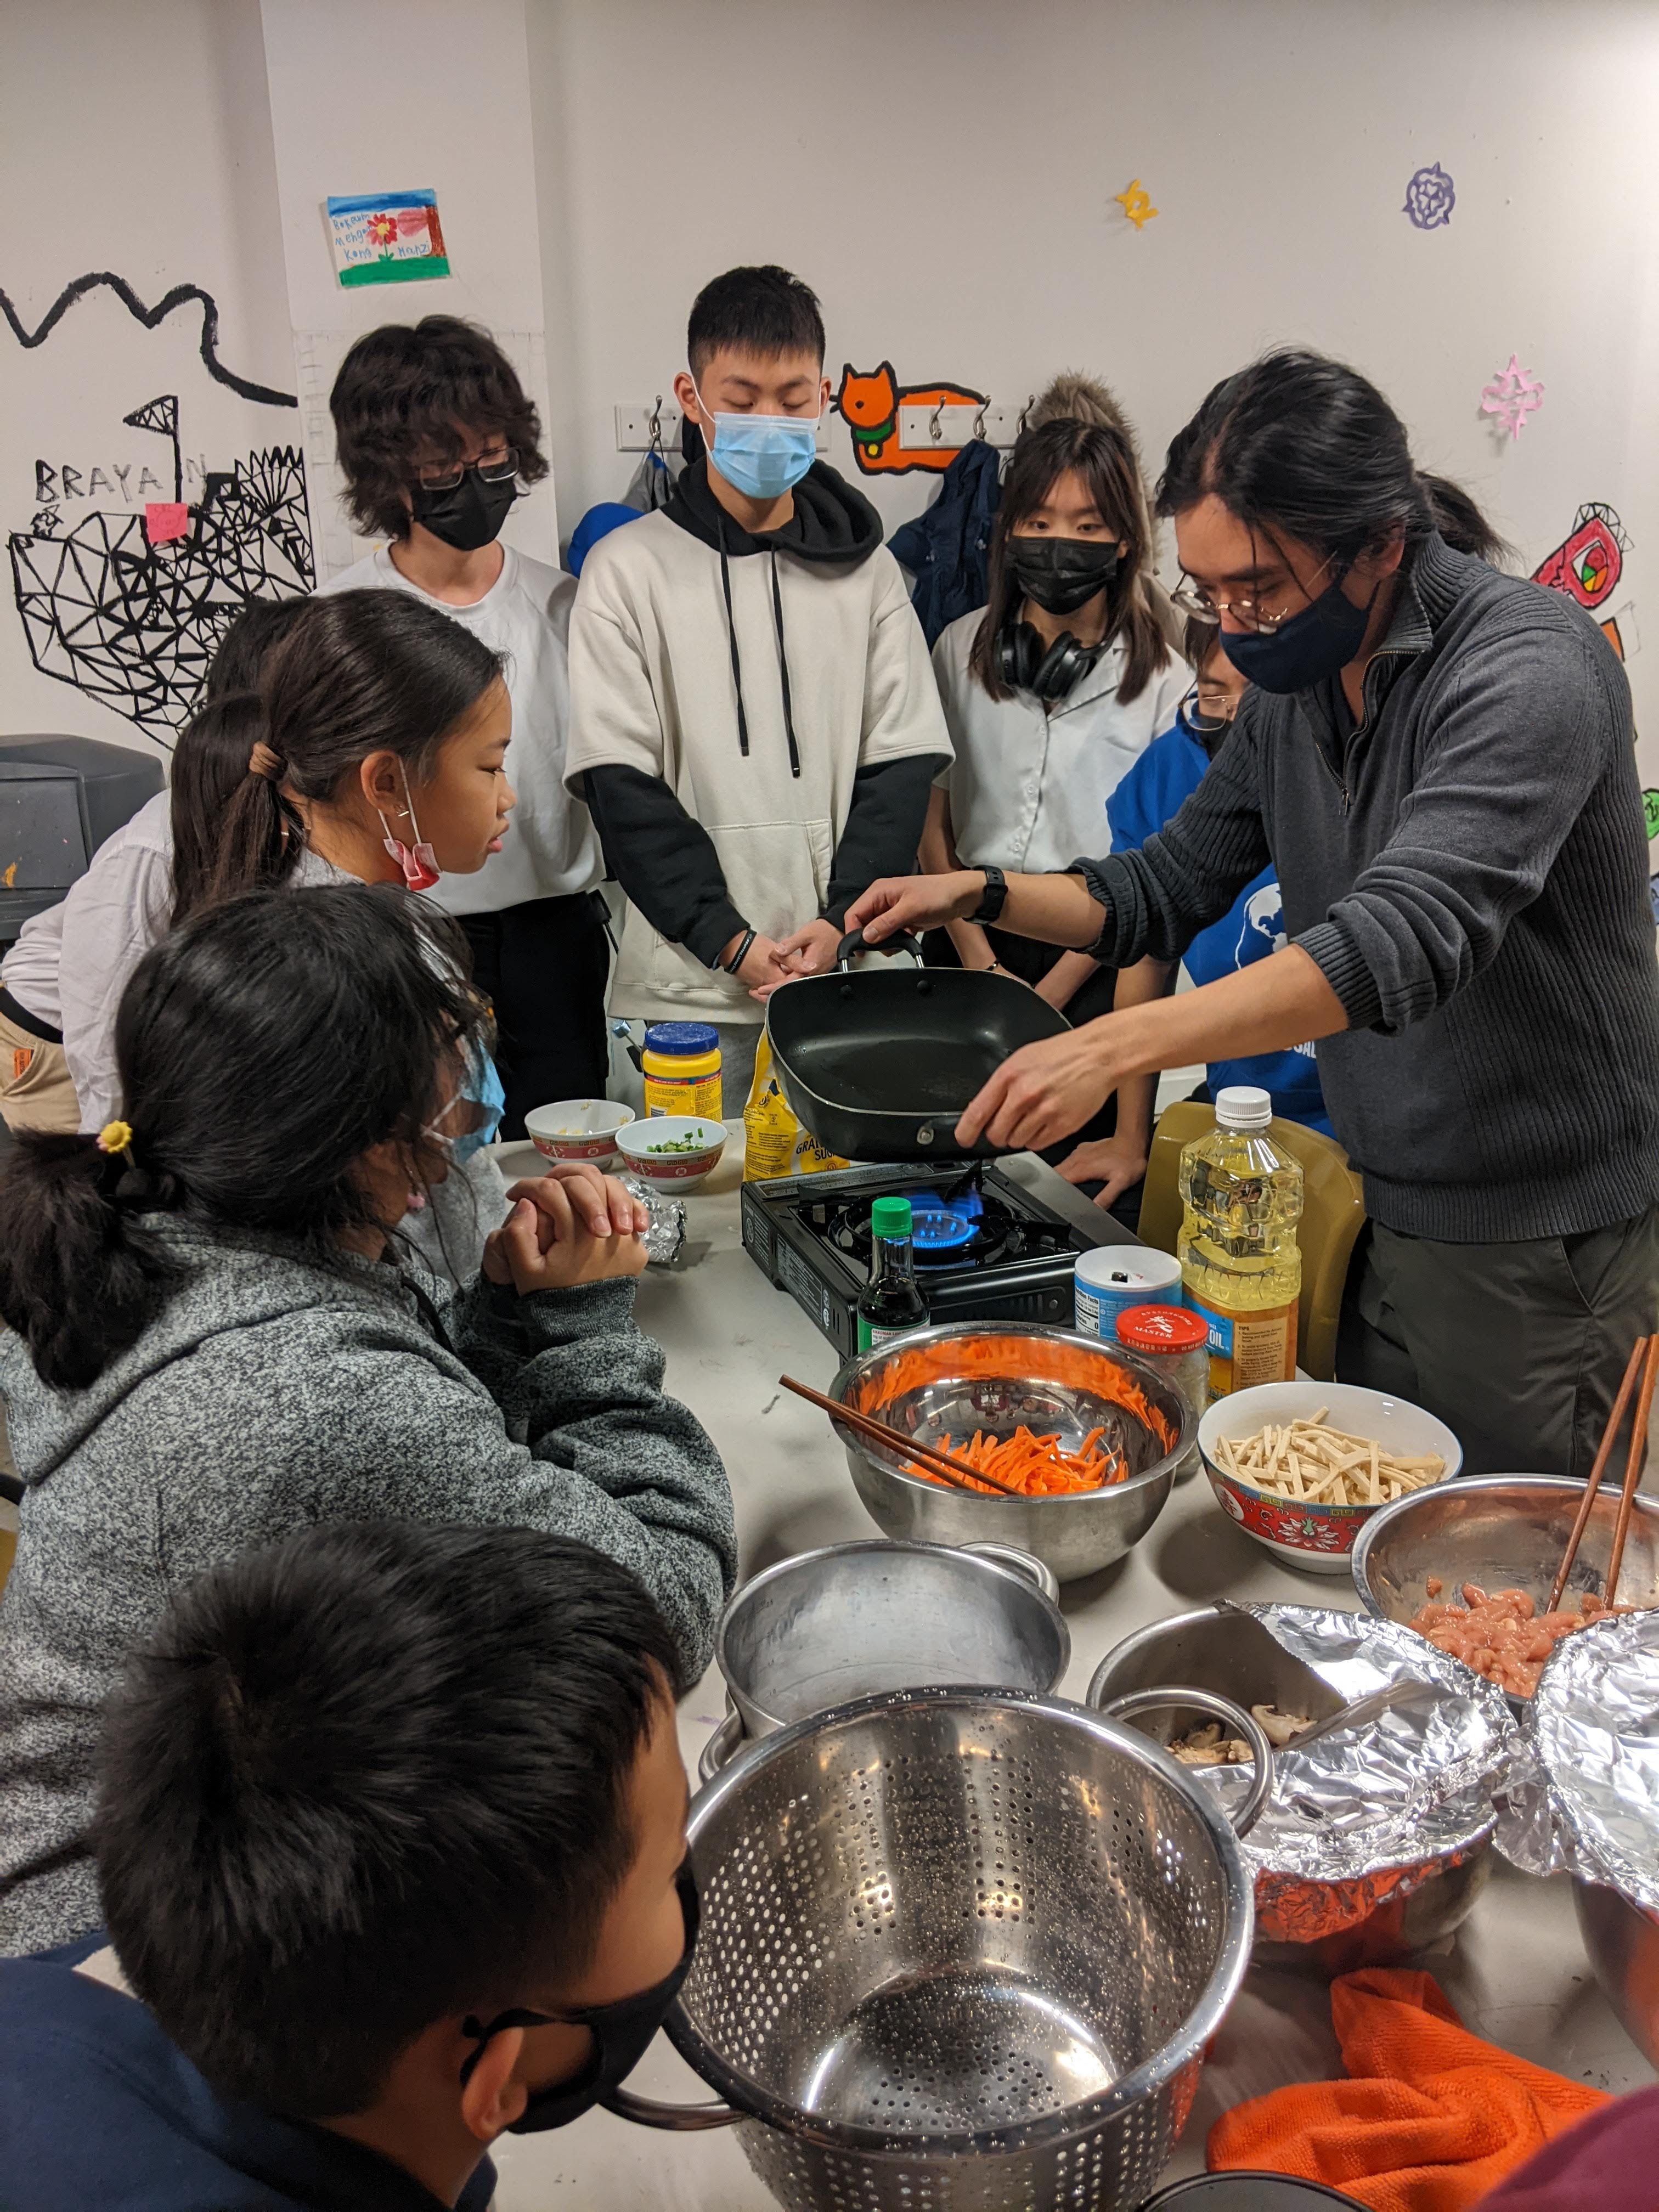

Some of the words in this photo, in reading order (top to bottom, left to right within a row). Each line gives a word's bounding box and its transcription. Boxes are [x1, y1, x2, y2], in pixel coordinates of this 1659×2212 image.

[815, 1148, 834, 1161] SUG
[1133, 1326, 1172, 1339] MASTER
[1209, 1329, 1224, 1350] OIL
